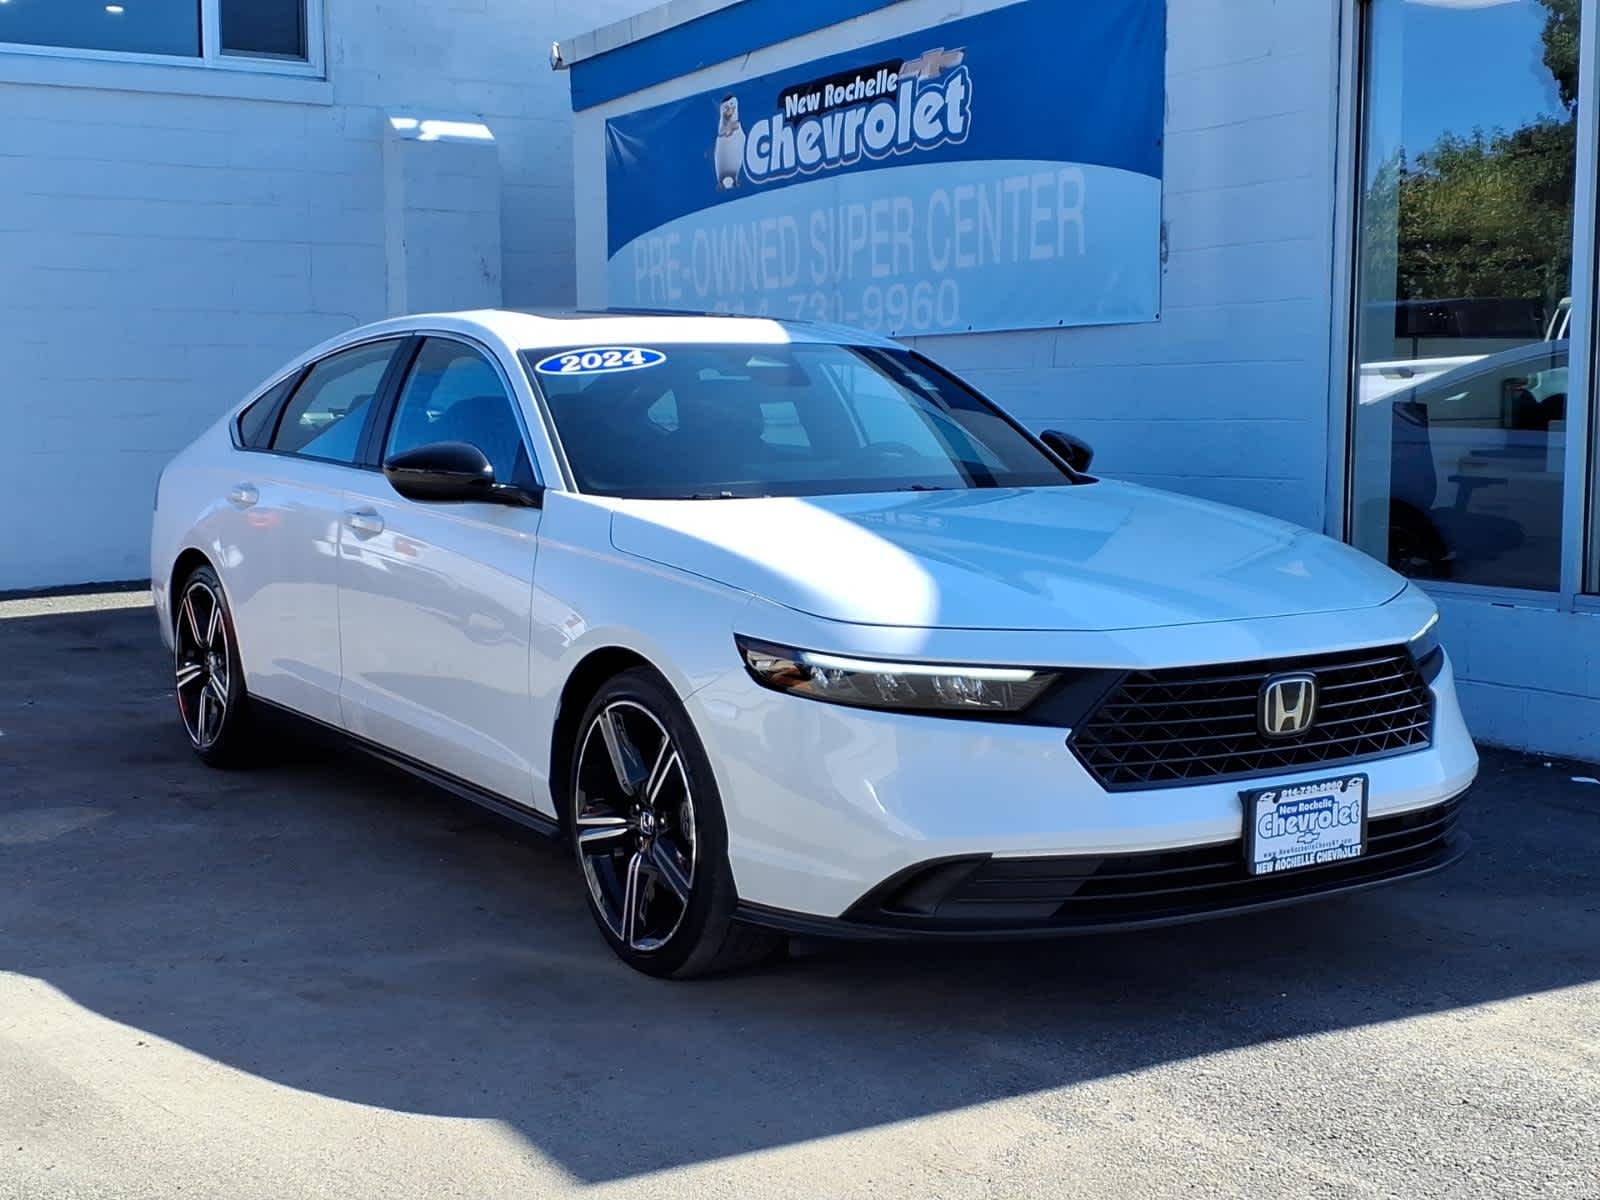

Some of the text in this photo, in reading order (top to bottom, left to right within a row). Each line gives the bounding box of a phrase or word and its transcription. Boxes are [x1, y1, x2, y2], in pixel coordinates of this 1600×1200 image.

[785, 69, 897, 118] New Rochelle
[745, 74, 966, 176] Chevrolet
[633, 166, 1086, 304] PRE-OWNED SUPER CENTER
[714, 279, 960, 332] 730-9960
[560, 350, 647, 373] 2024
[1258, 800, 1360, 839] Chevrolet
[1280, 799, 1333, 816] New Rochelle
[1256, 844, 1362, 875] NEW ROCHELLE CHEVROLET
